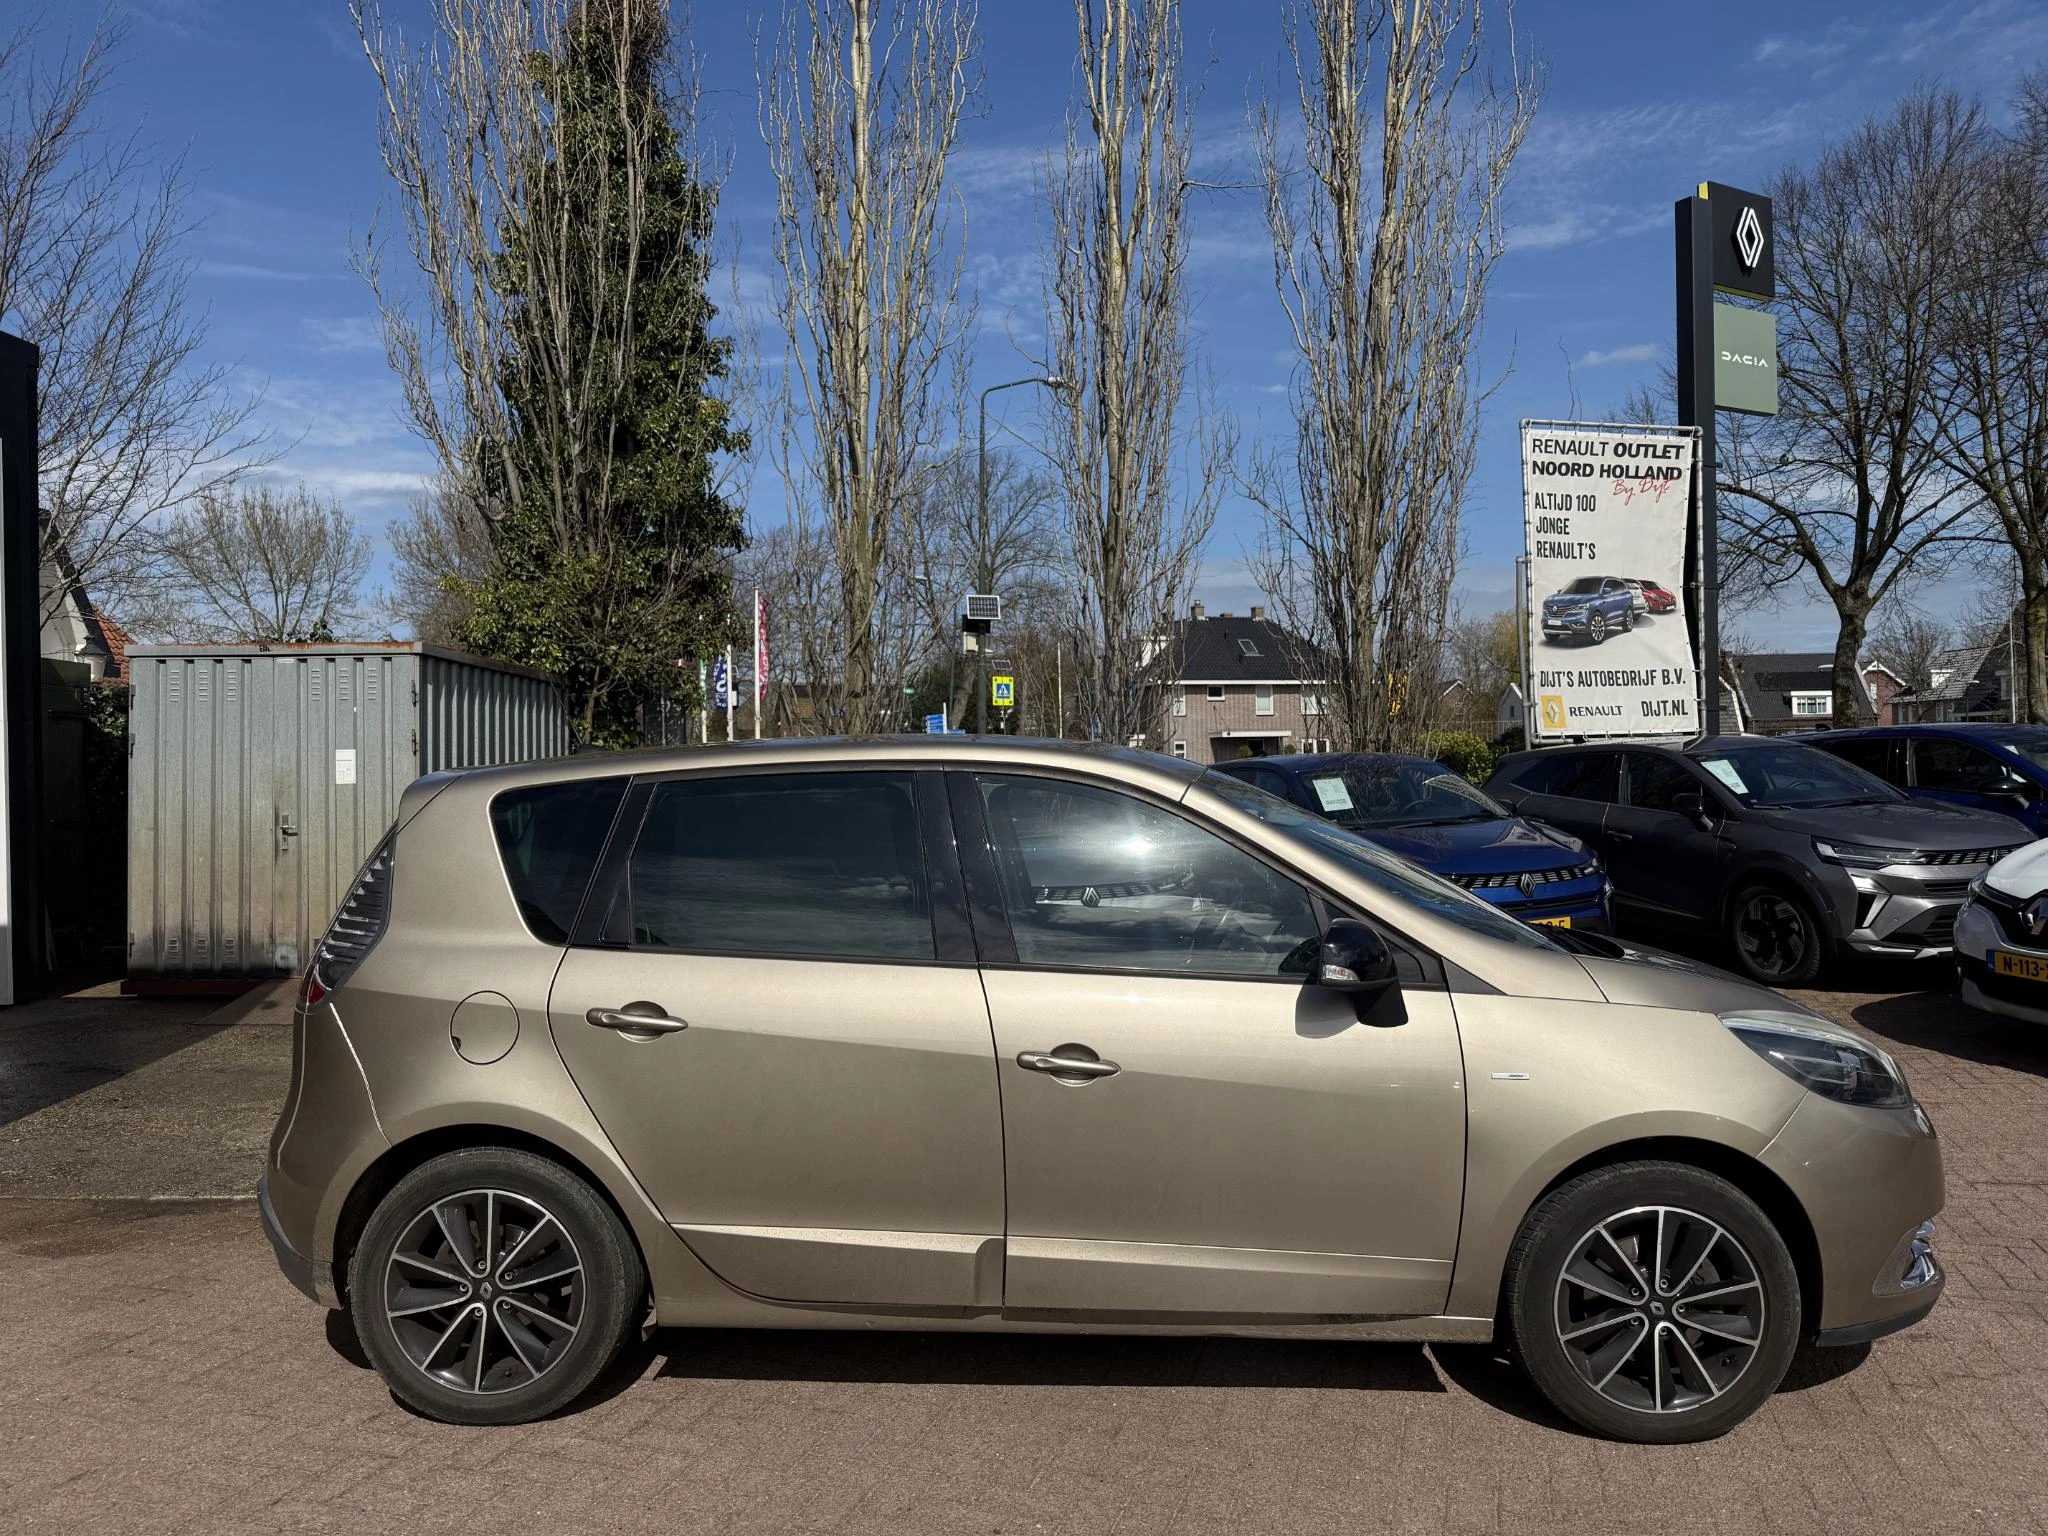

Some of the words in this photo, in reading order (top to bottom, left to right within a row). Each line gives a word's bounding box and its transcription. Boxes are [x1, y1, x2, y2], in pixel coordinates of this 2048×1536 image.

[1721, 350, 1768, 367] DACIA
[1532, 438, 1609, 457] RENAULT
[1613, 442, 1685, 460] OUTLET
[1532, 460, 1595, 478] NOORD
[1600, 464, 1683, 481] HOLLAND
[1535, 492, 1572, 511] ALTIJD
[1576, 494, 1596, 512] 100
[1612, 479, 1635, 506] By
[1536, 516, 1570, 535] JONGE
[1536, 540, 1596, 560] RENAULT'S
[1540, 670, 1574, 688] DIJT'S
[1578, 669, 1657, 688] AUTOBEDRIJF
[1662, 668, 1686, 685] B.V.
[1569, 705, 1623, 717] RENAULT
[1641, 699, 1689, 717] DIJT.NL
